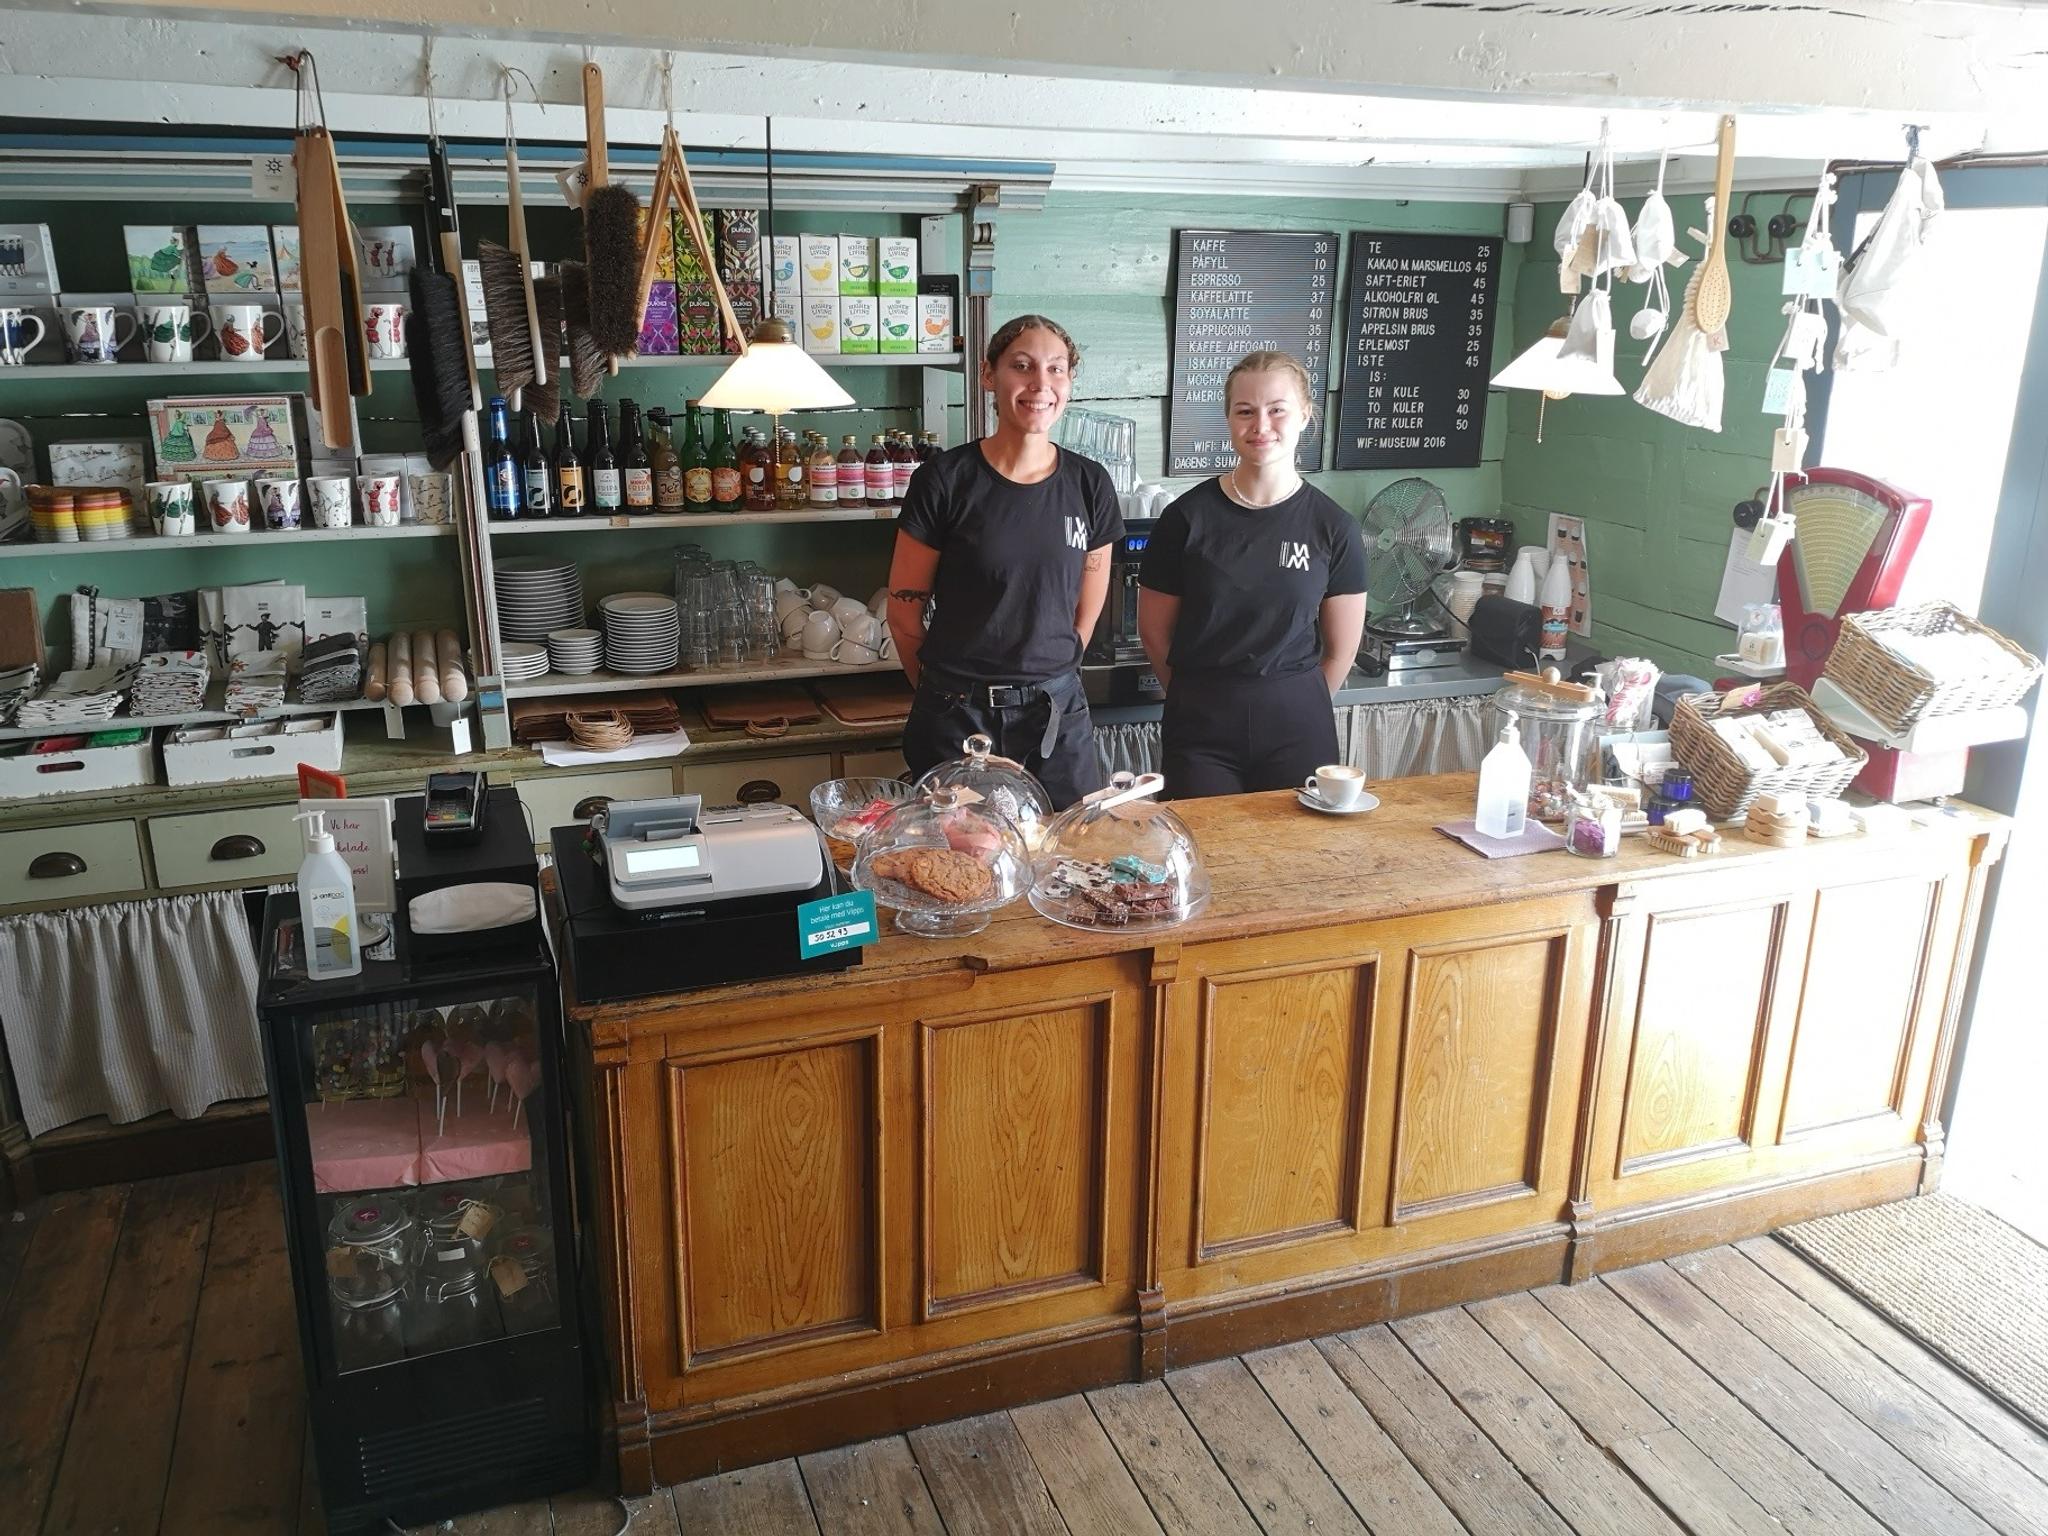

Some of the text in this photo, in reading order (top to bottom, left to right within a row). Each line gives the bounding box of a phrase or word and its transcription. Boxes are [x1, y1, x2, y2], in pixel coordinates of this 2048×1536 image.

[1193, 240, 1328, 253] KAFFE 30
[1369, 242, 1490, 257] TE 25
[1192, 255, 1326, 270] PÅFYLL 10
[1367, 258, 1398, 270] KAKAO
[1411, 260, 1472, 273] MARSMELLOS
[1475, 262, 1487, 273] 45
[1191, 274, 1325, 287] ESPRESSO 25
[1365, 275, 1486, 289] SAFT-ERIET 45
[1190, 291, 1324, 303] KAFFELATTE 37
[1364, 291, 1485, 305] ALKOHOLFRI ØL 45
[1189, 308, 1322, 320] SOYALATTE 40
[1362, 307, 1483, 320] SITRON BRUS 35
[1188, 325, 1321, 336] CAPPUCCINO 35
[1361, 323, 1482, 336] APPELSIN BRUS 35
[1188, 340, 1320, 352] KAFFE AFFOGATO 45
[1358, 339, 1480, 351] EPLEMOST 25
[1188, 356, 1319, 370] ISKAFFE 37
[1358, 355, 1479, 367] ISTE 45
[1186, 374, 1222, 386] MOCHA
[1185, 390, 1224, 402] AMERIC
[1368, 386, 1470, 400] EN KULE 30
[1367, 402, 1469, 415] TO KULER 40
[1367, 417, 1468, 430] TRE KULER 50
[1193, 441, 1216, 452] WIFI:
[1423, 437, 1446, 447] 2016
[1174, 457, 1211, 469] DAGENS:
[819, 905, 831, 913] Her
[832, 902, 844, 910] kan
[810, 915, 830, 925] betale
[831, 911, 845, 919] med
[847, 907, 865, 916] Vipps
